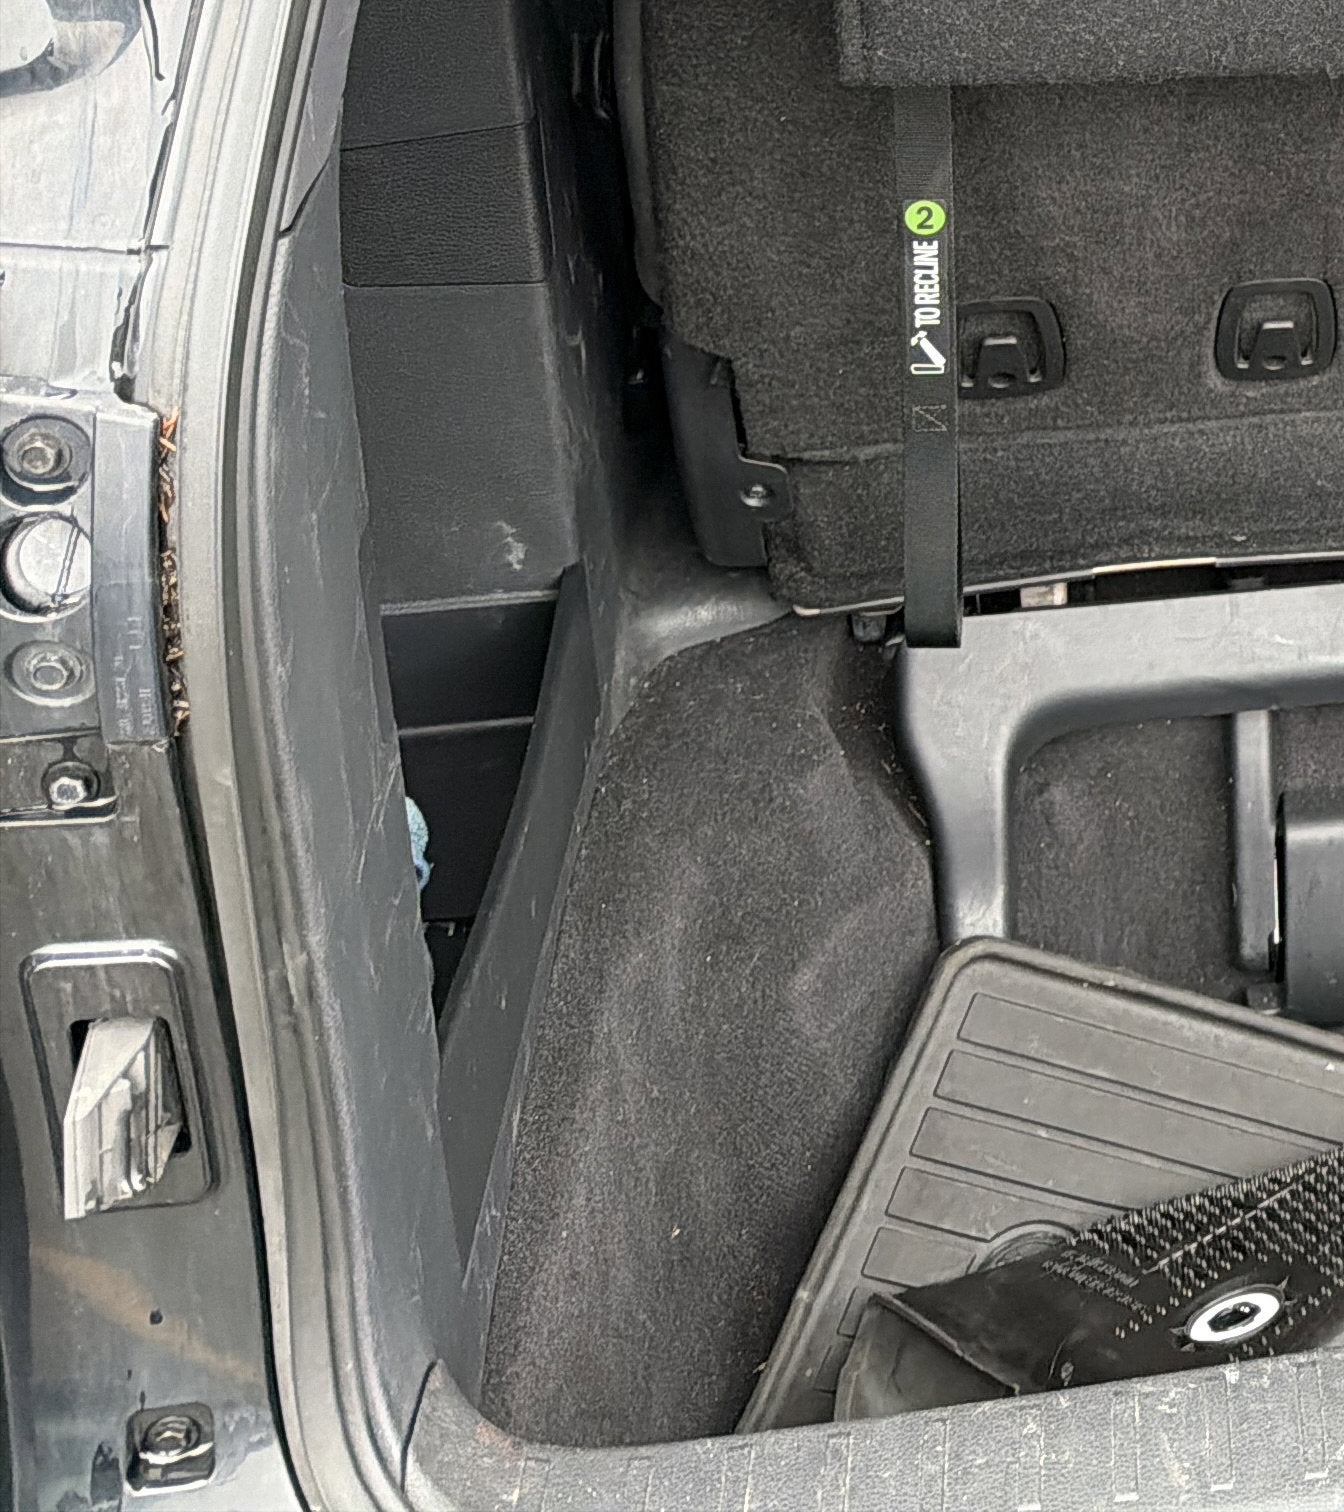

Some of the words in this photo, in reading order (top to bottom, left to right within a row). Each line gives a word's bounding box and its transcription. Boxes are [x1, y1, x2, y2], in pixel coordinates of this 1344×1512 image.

[916, 205, 935, 231] 2
[912, 239, 941, 306] RECLINE
[914, 306, 941, 329] TO
